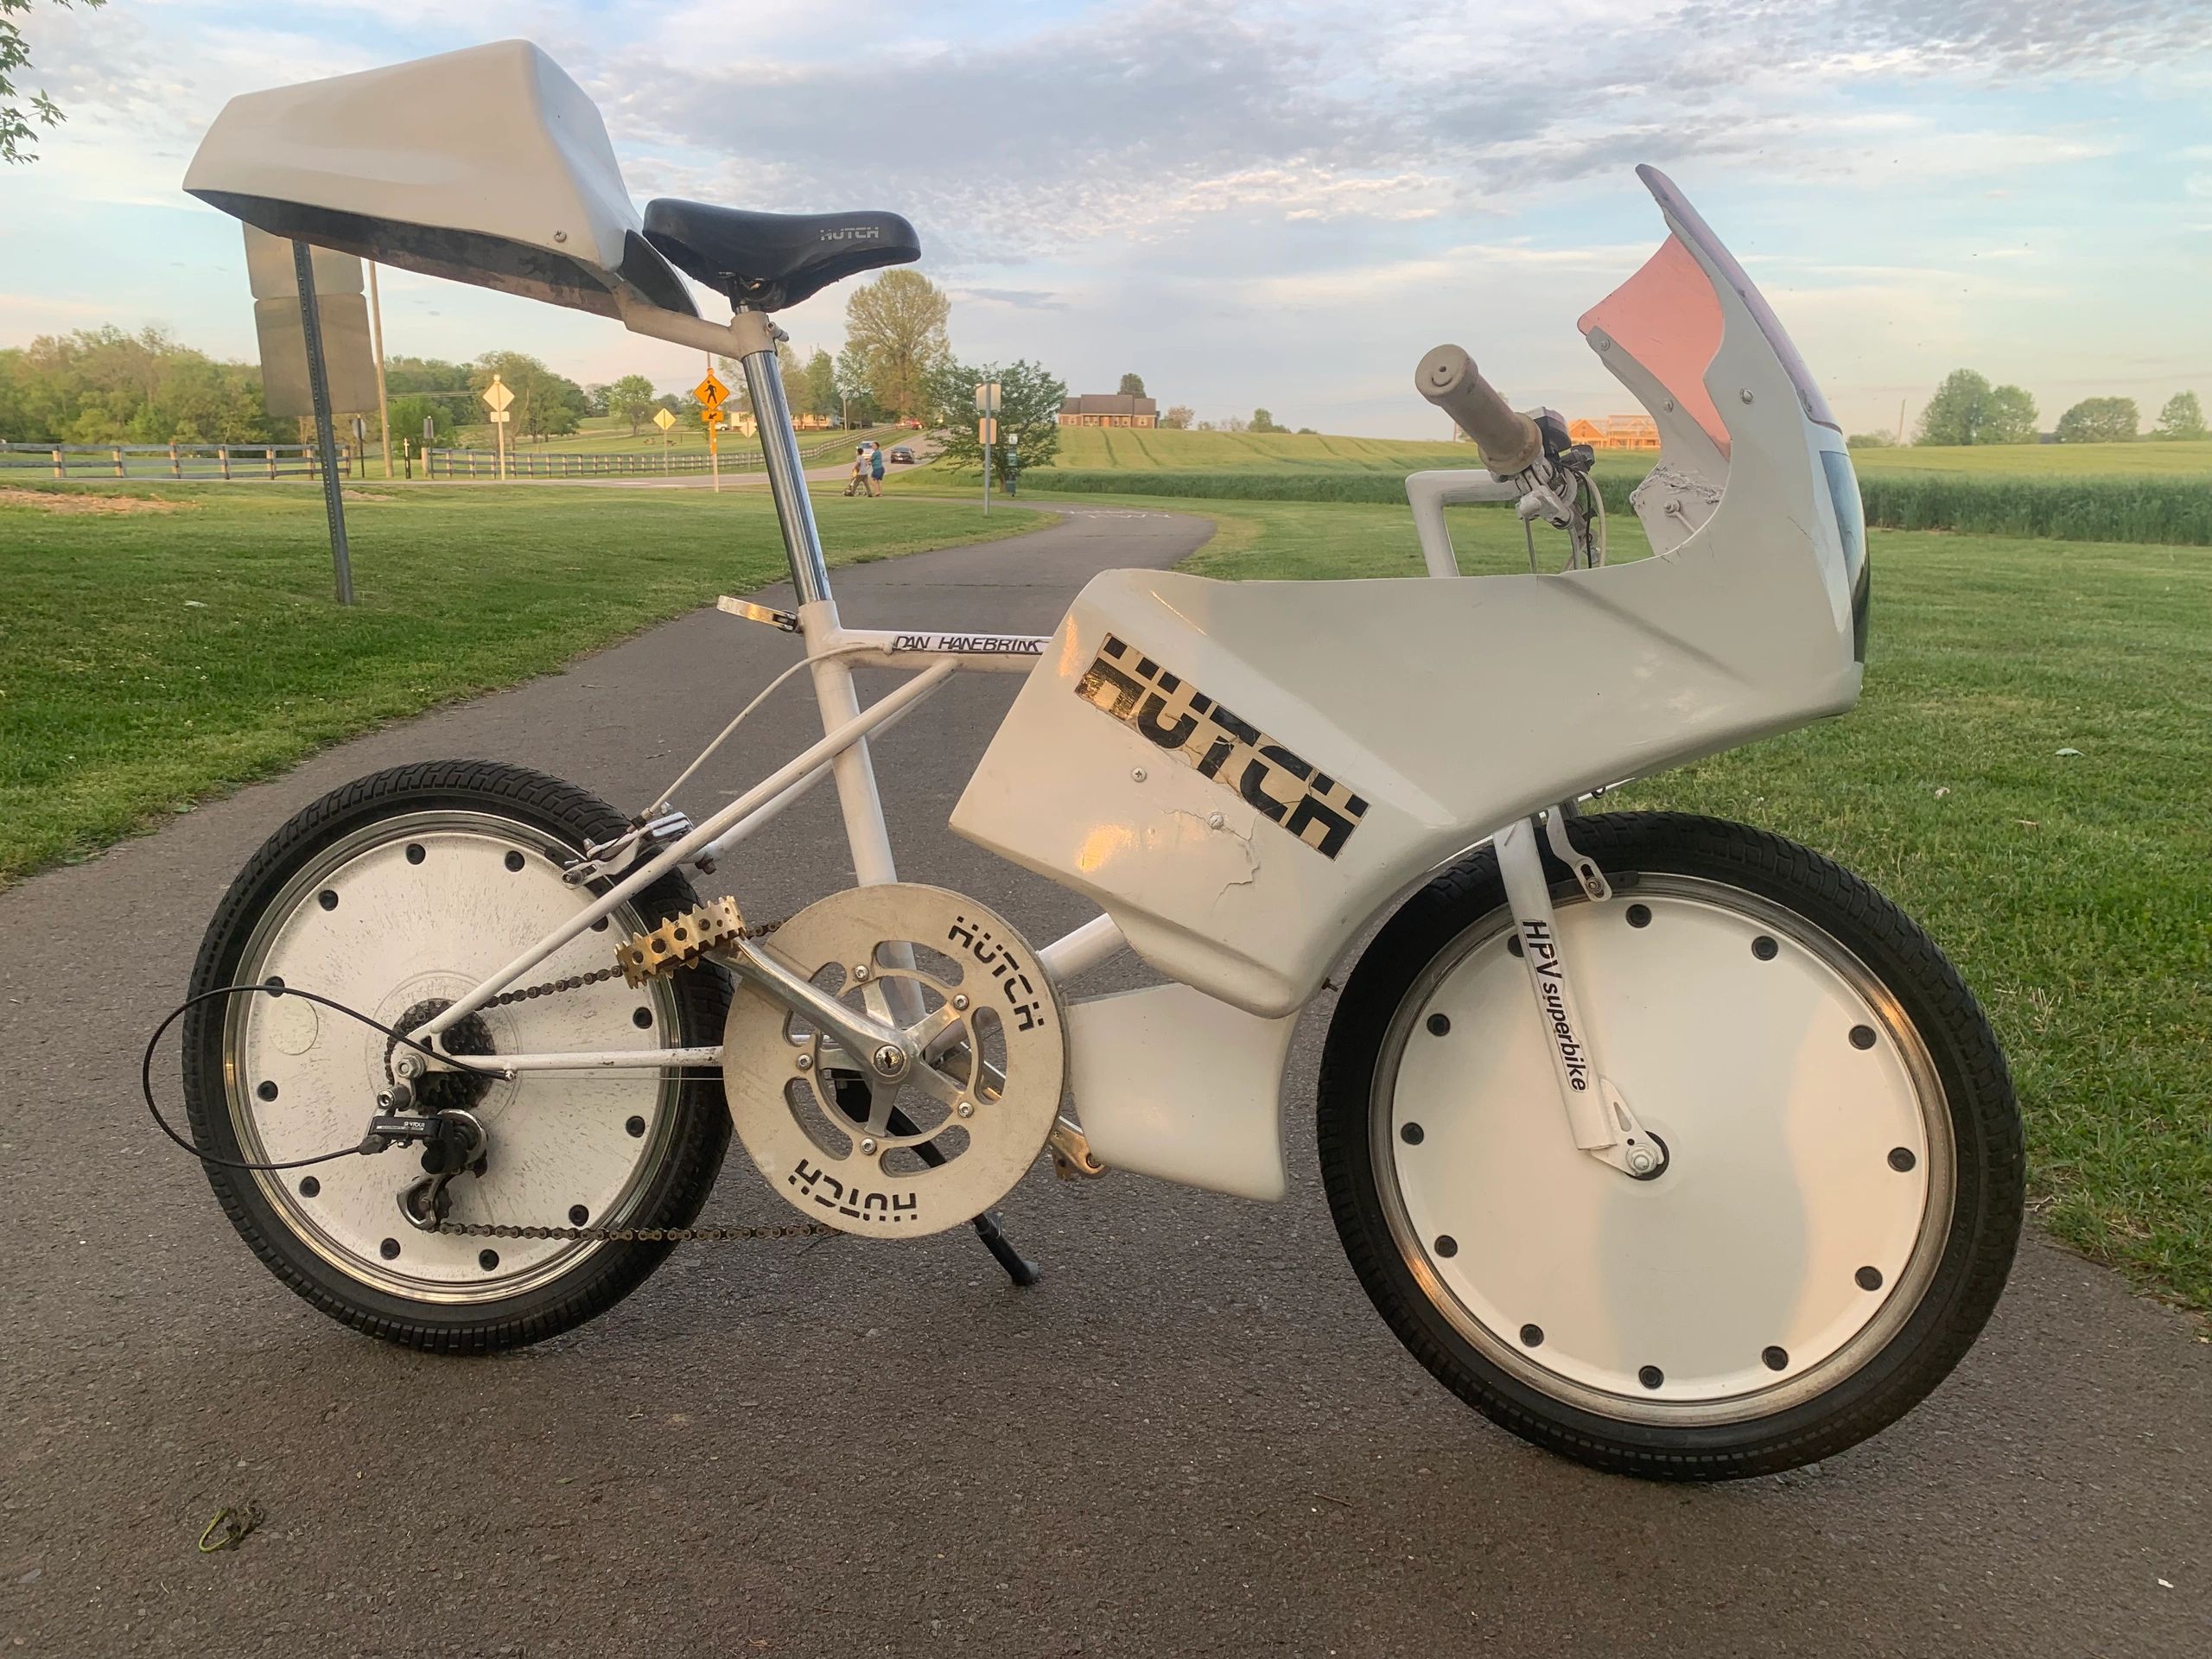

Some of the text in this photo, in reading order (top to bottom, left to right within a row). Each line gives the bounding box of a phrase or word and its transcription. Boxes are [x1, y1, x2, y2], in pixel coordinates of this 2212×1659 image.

[821, 226, 879, 241] HUTCH
[895, 636, 1040, 652] DAN HANEBRINK
[1075, 635, 1370, 861] HUTCH
[948, 916, 1045, 1032] HUTCH
[1522, 921, 1586, 1091] HPV superbike
[788, 1159, 918, 1222] HUTCH
